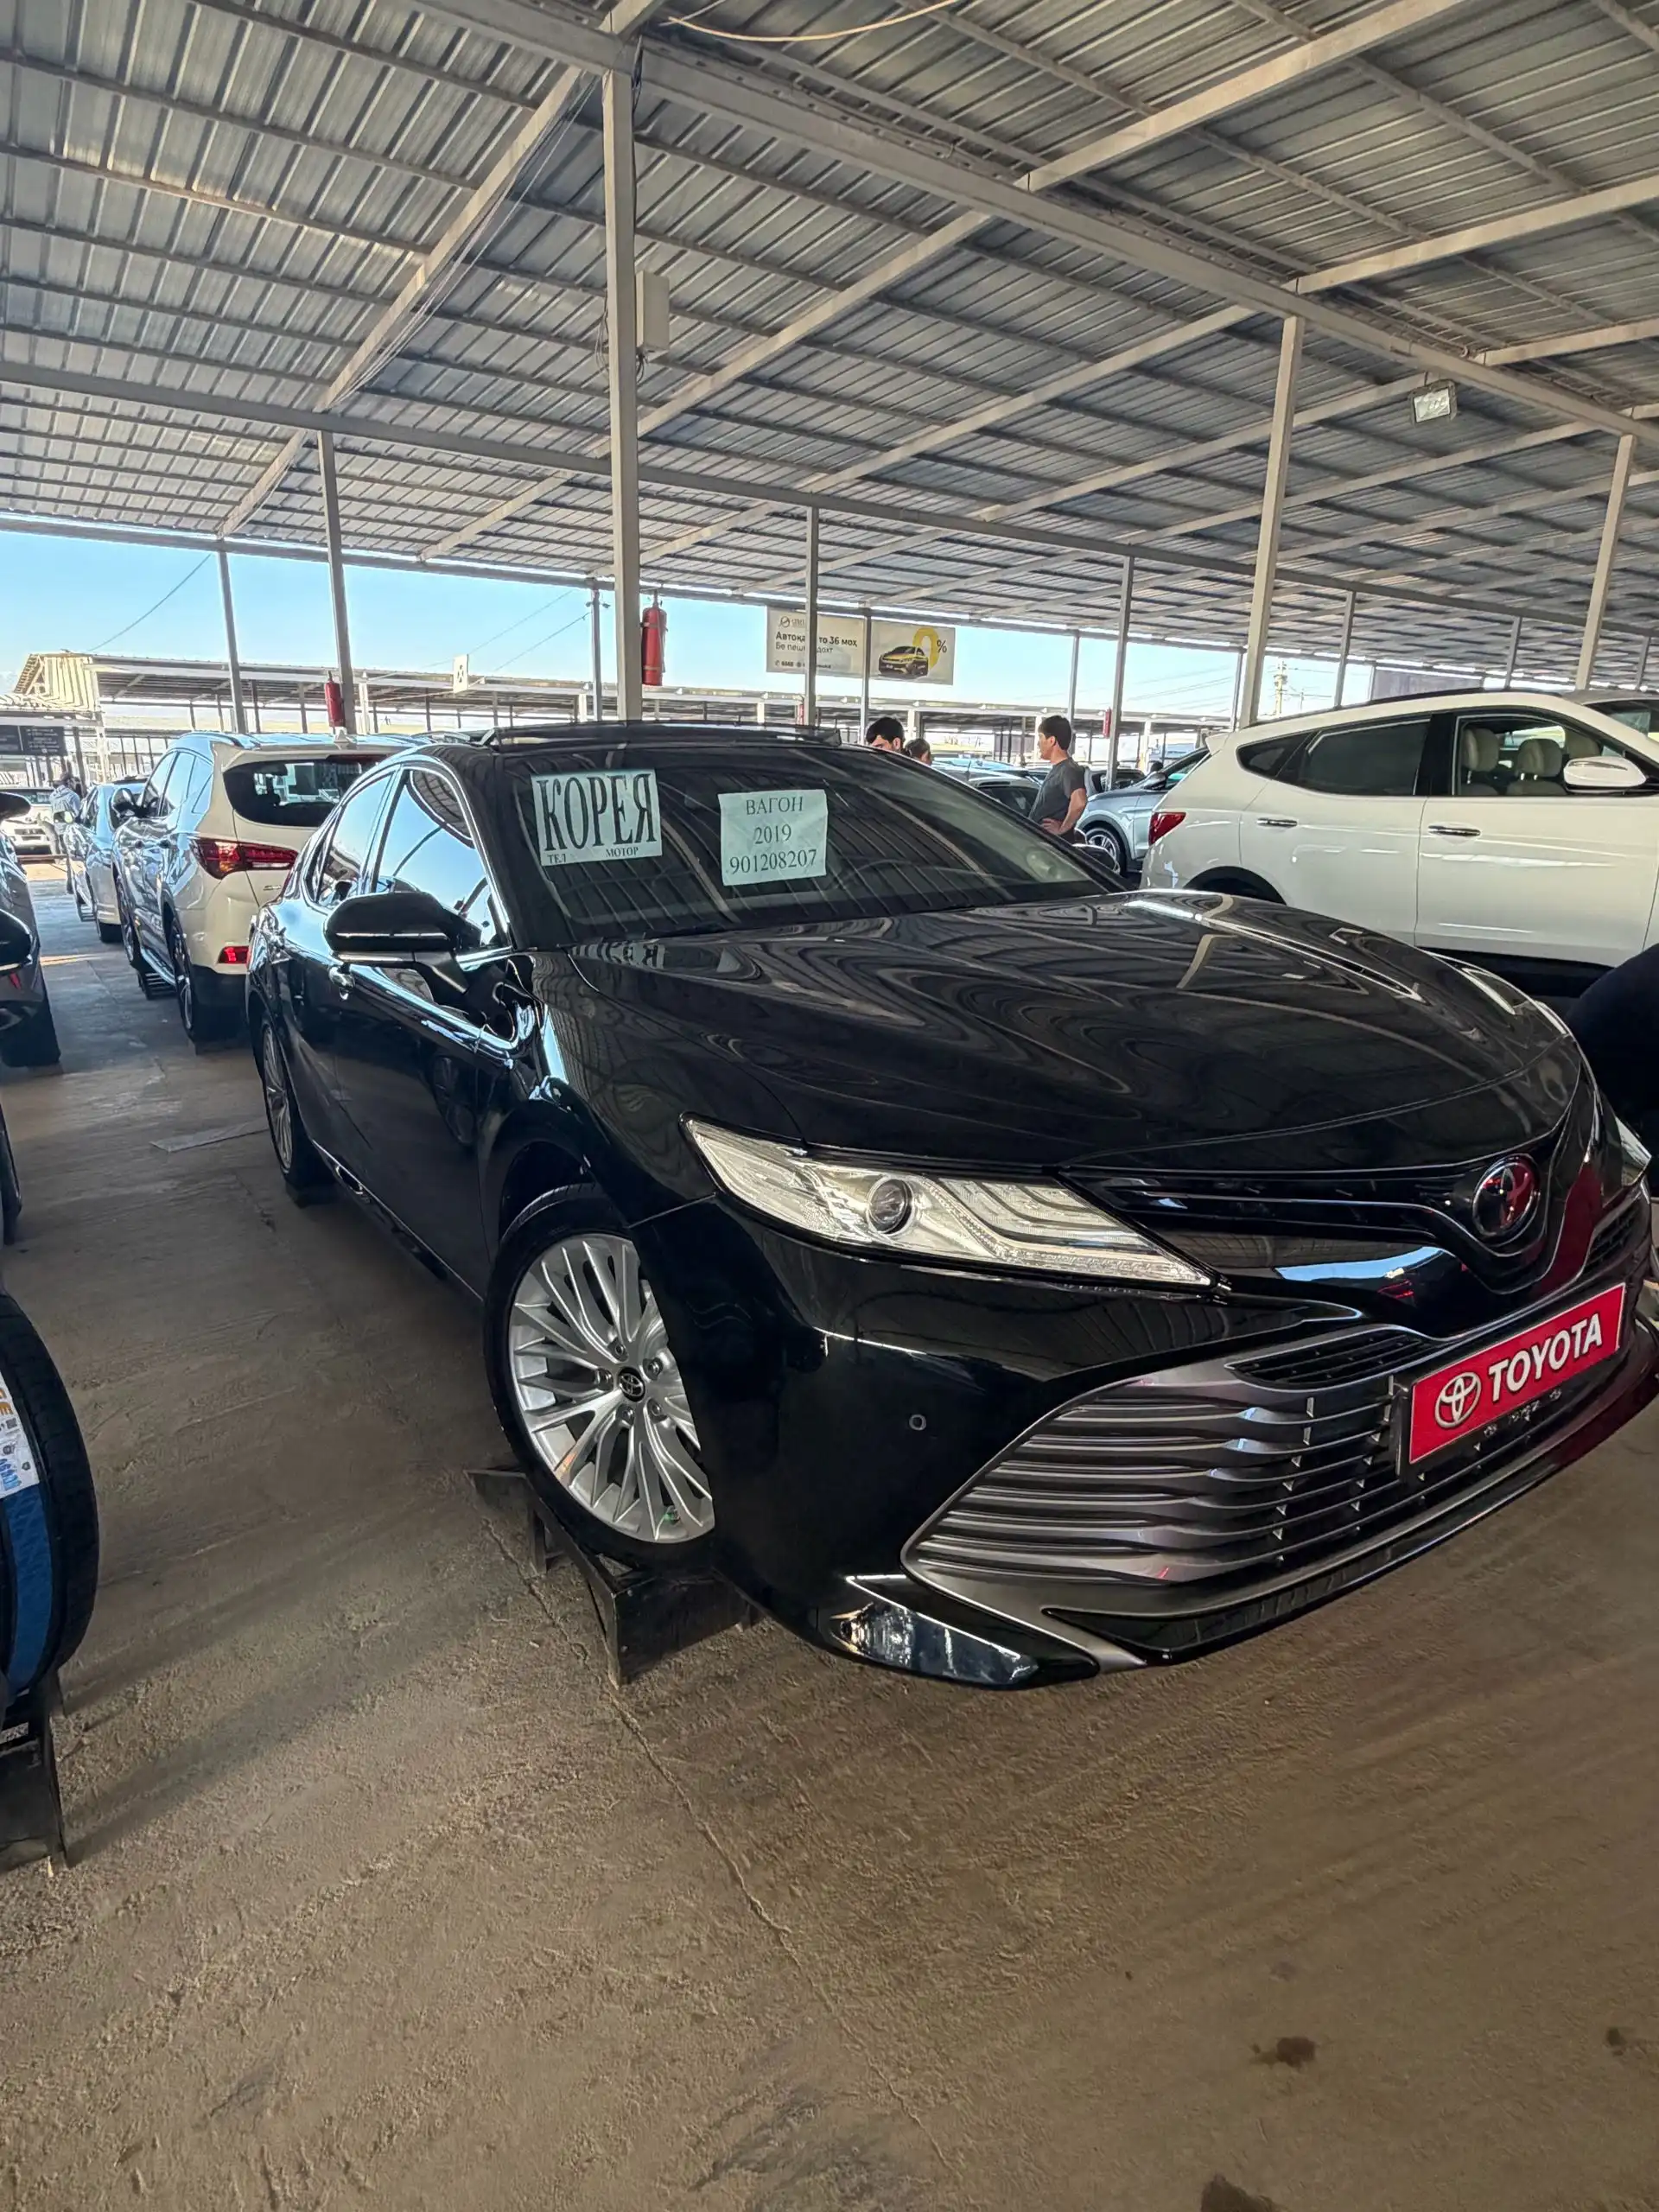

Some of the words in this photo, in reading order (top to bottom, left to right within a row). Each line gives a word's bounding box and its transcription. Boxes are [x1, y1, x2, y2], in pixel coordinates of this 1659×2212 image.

[776, 631, 806, 643] Автоқа
[829, 636, 840, 645] 36
[776, 641, 786, 651] Бе
[537, 773, 657, 851] КОРЕЯ
[746, 796, 803, 816] ВАГОН
[754, 823, 792, 845] 2019
[606, 847, 639, 858] МОТОР
[729, 849, 817, 874] 901208207
[1488, 1313, 1603, 1403] TOYOTA
